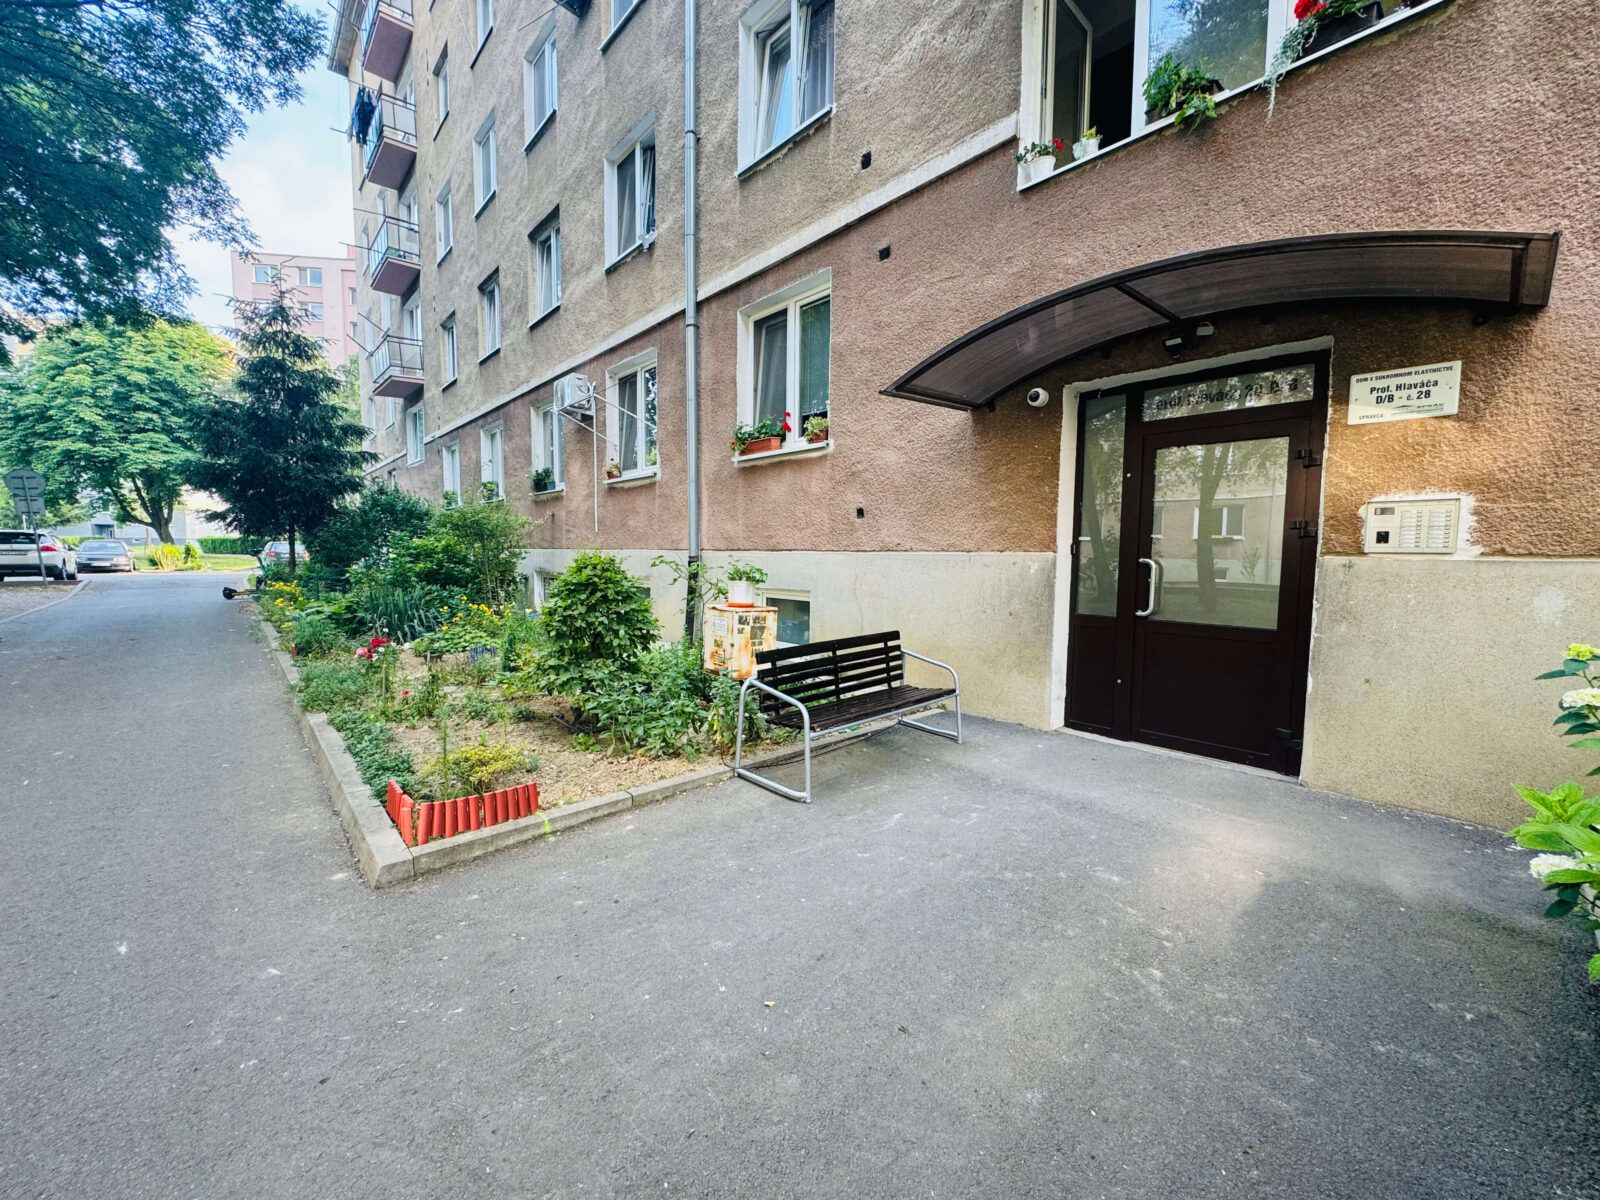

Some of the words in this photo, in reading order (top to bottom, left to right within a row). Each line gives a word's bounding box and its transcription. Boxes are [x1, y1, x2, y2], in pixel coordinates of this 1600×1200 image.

[1370, 385, 1392, 395] Prof.
[1395, 379, 1439, 391] Hlaváča
[1376, 394, 1394, 404] D/B
[1416, 389, 1431, 400] 28
